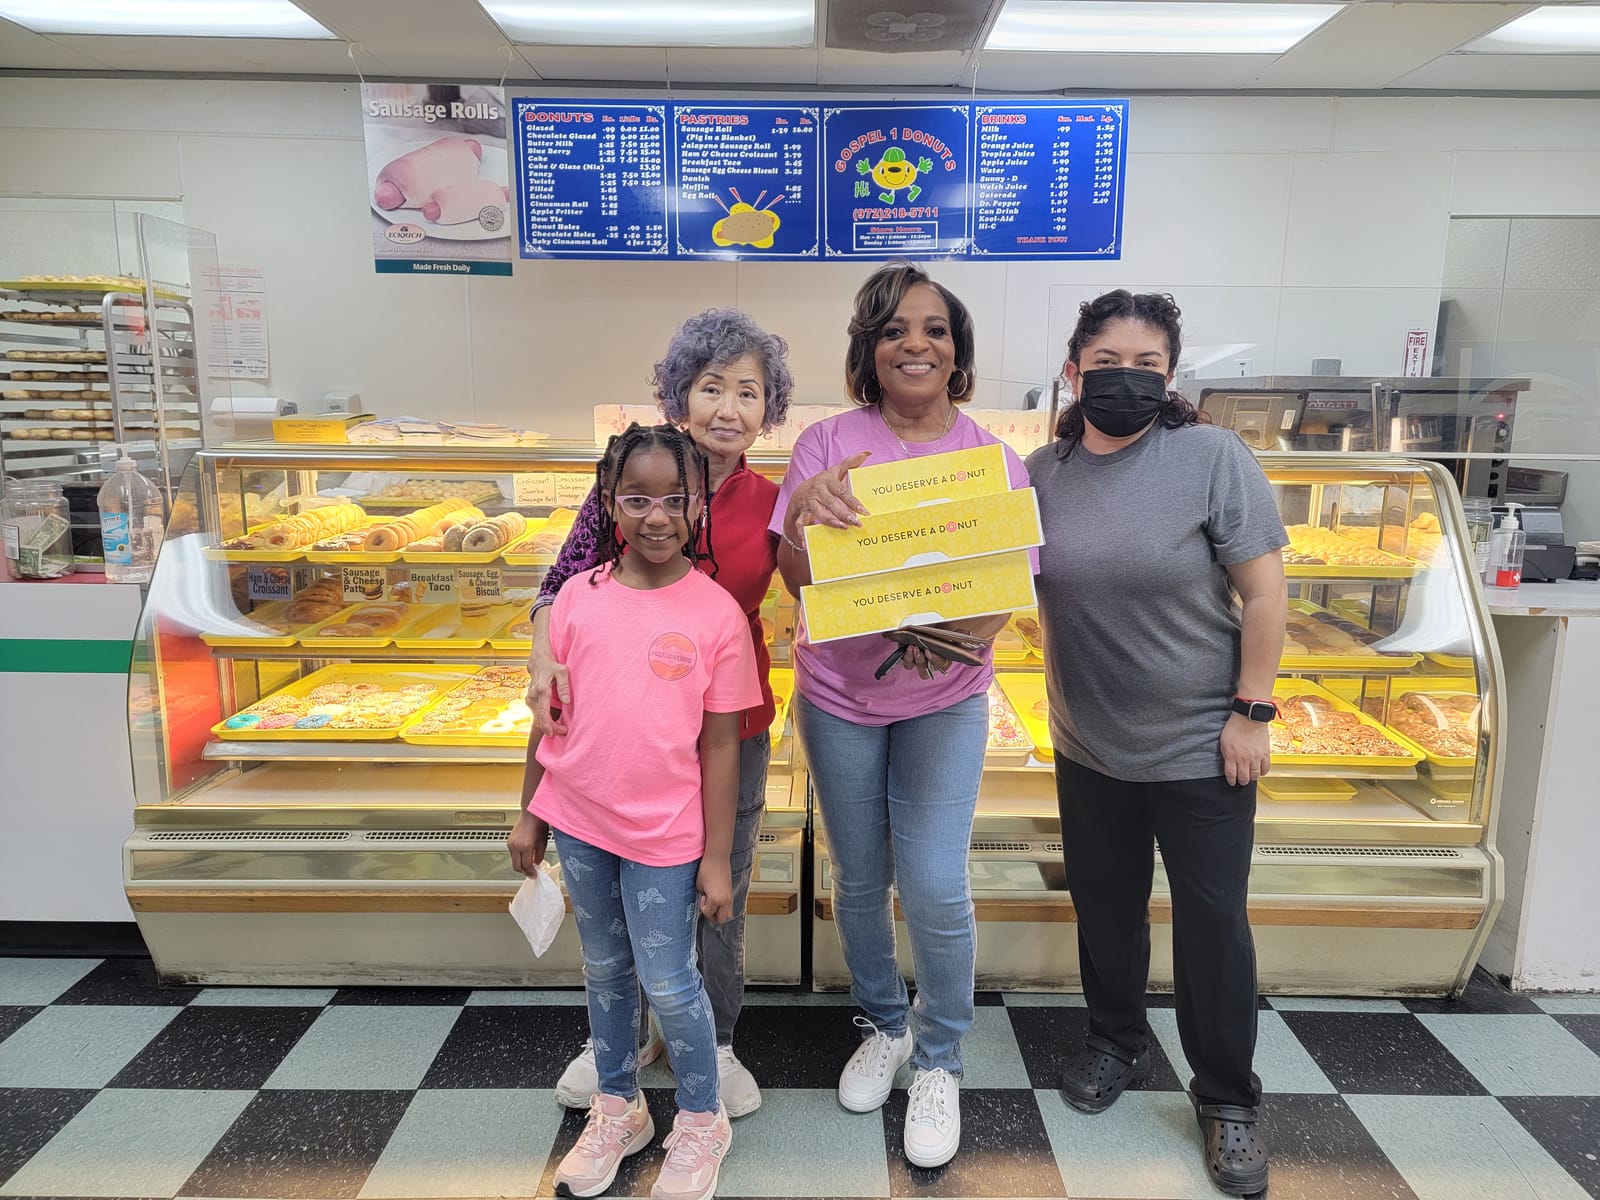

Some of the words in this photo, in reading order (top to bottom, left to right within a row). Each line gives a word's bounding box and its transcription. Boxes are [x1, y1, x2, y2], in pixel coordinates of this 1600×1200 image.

[369, 100, 445, 121] Sausage
[450, 102, 499, 121] Rolls
[524, 112, 594, 123] DONUTS
[679, 115, 749, 125] PASTRIES
[981, 114, 1026, 124] DRINKS
[835, 130, 886, 172] GOSPEL
[890, 128, 897, 139] 1
[902, 128, 956, 171] DONUTS
[855, 181, 870, 198] Hi
[853, 207, 938, 222] (972)218-5711
[1409, 337, 1425, 346] FIRE
[872, 485, 892, 496] YOU
[896, 478, 938, 492] DESERVE
[950, 468, 986, 482] DONUT
[857, 536, 878, 547] YOU
[882, 528, 926, 543] DESERVE
[939, 520, 978, 533] DONUT
[343, 568, 380, 578] Sausage
[353, 577, 385, 585] Cheese
[253, 584, 288, 595] Croissant
[429, 583, 450, 591] Taco
[476, 587, 500, 596] Biscuit
[853, 596, 874, 607] YOU
[877, 588, 922, 603] DESERVE
[934, 580, 972, 594] DONUT
